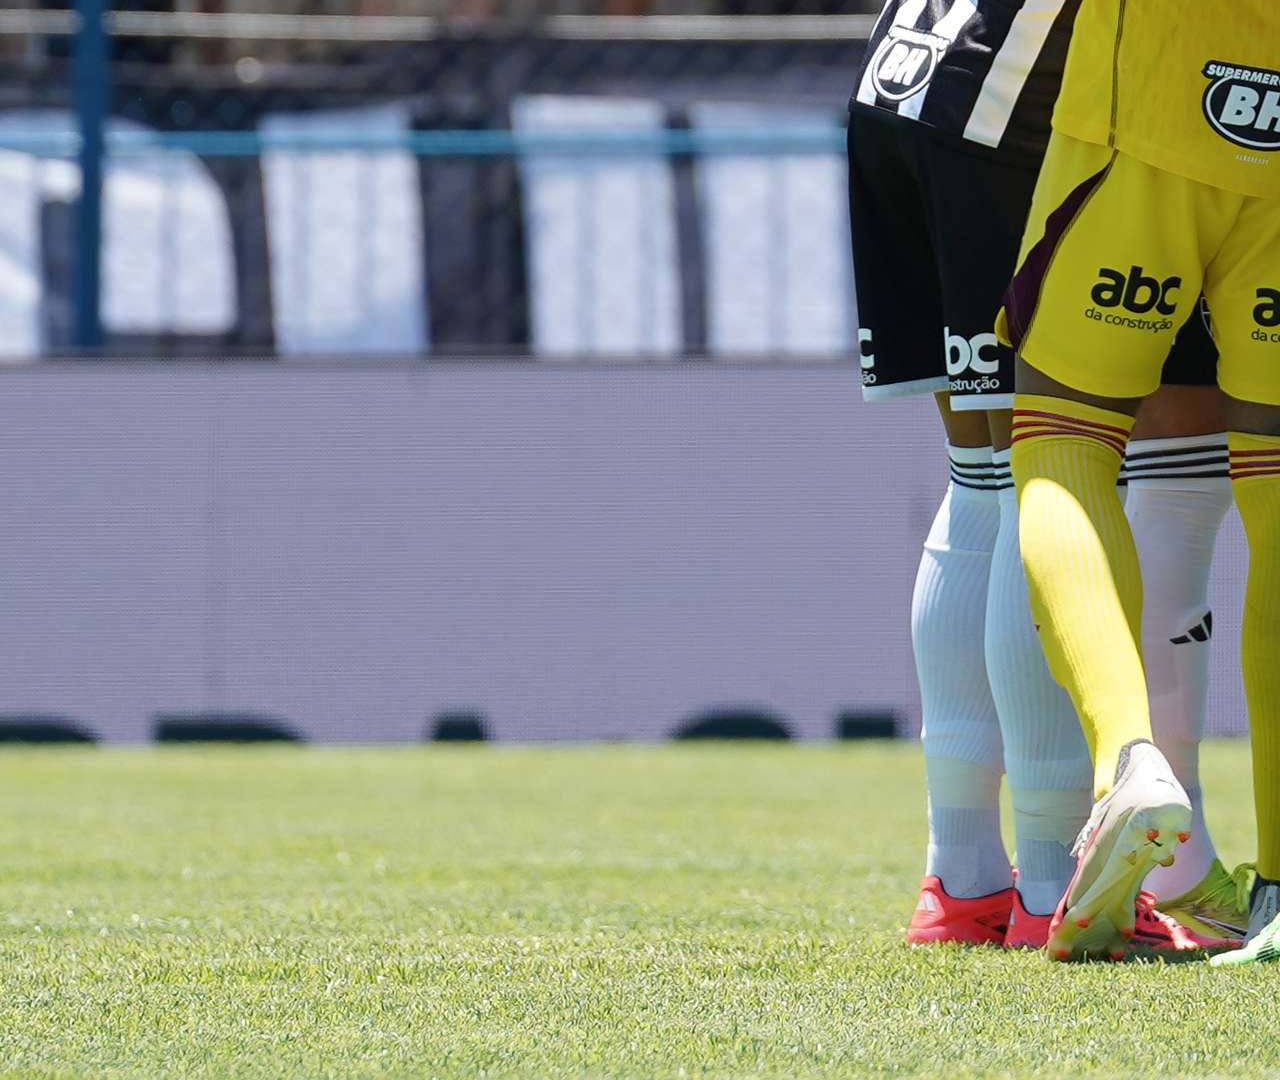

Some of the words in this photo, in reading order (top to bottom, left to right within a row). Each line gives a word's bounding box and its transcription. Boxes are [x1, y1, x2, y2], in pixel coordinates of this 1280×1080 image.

[878, 42, 929, 87] BH
[1091, 265, 1182, 316] abc
[1085, 306, 1102, 321] da
[1105, 312, 1173, 333] construção
[1251, 328, 1267, 342] da
[944, 325, 1000, 376] bc
